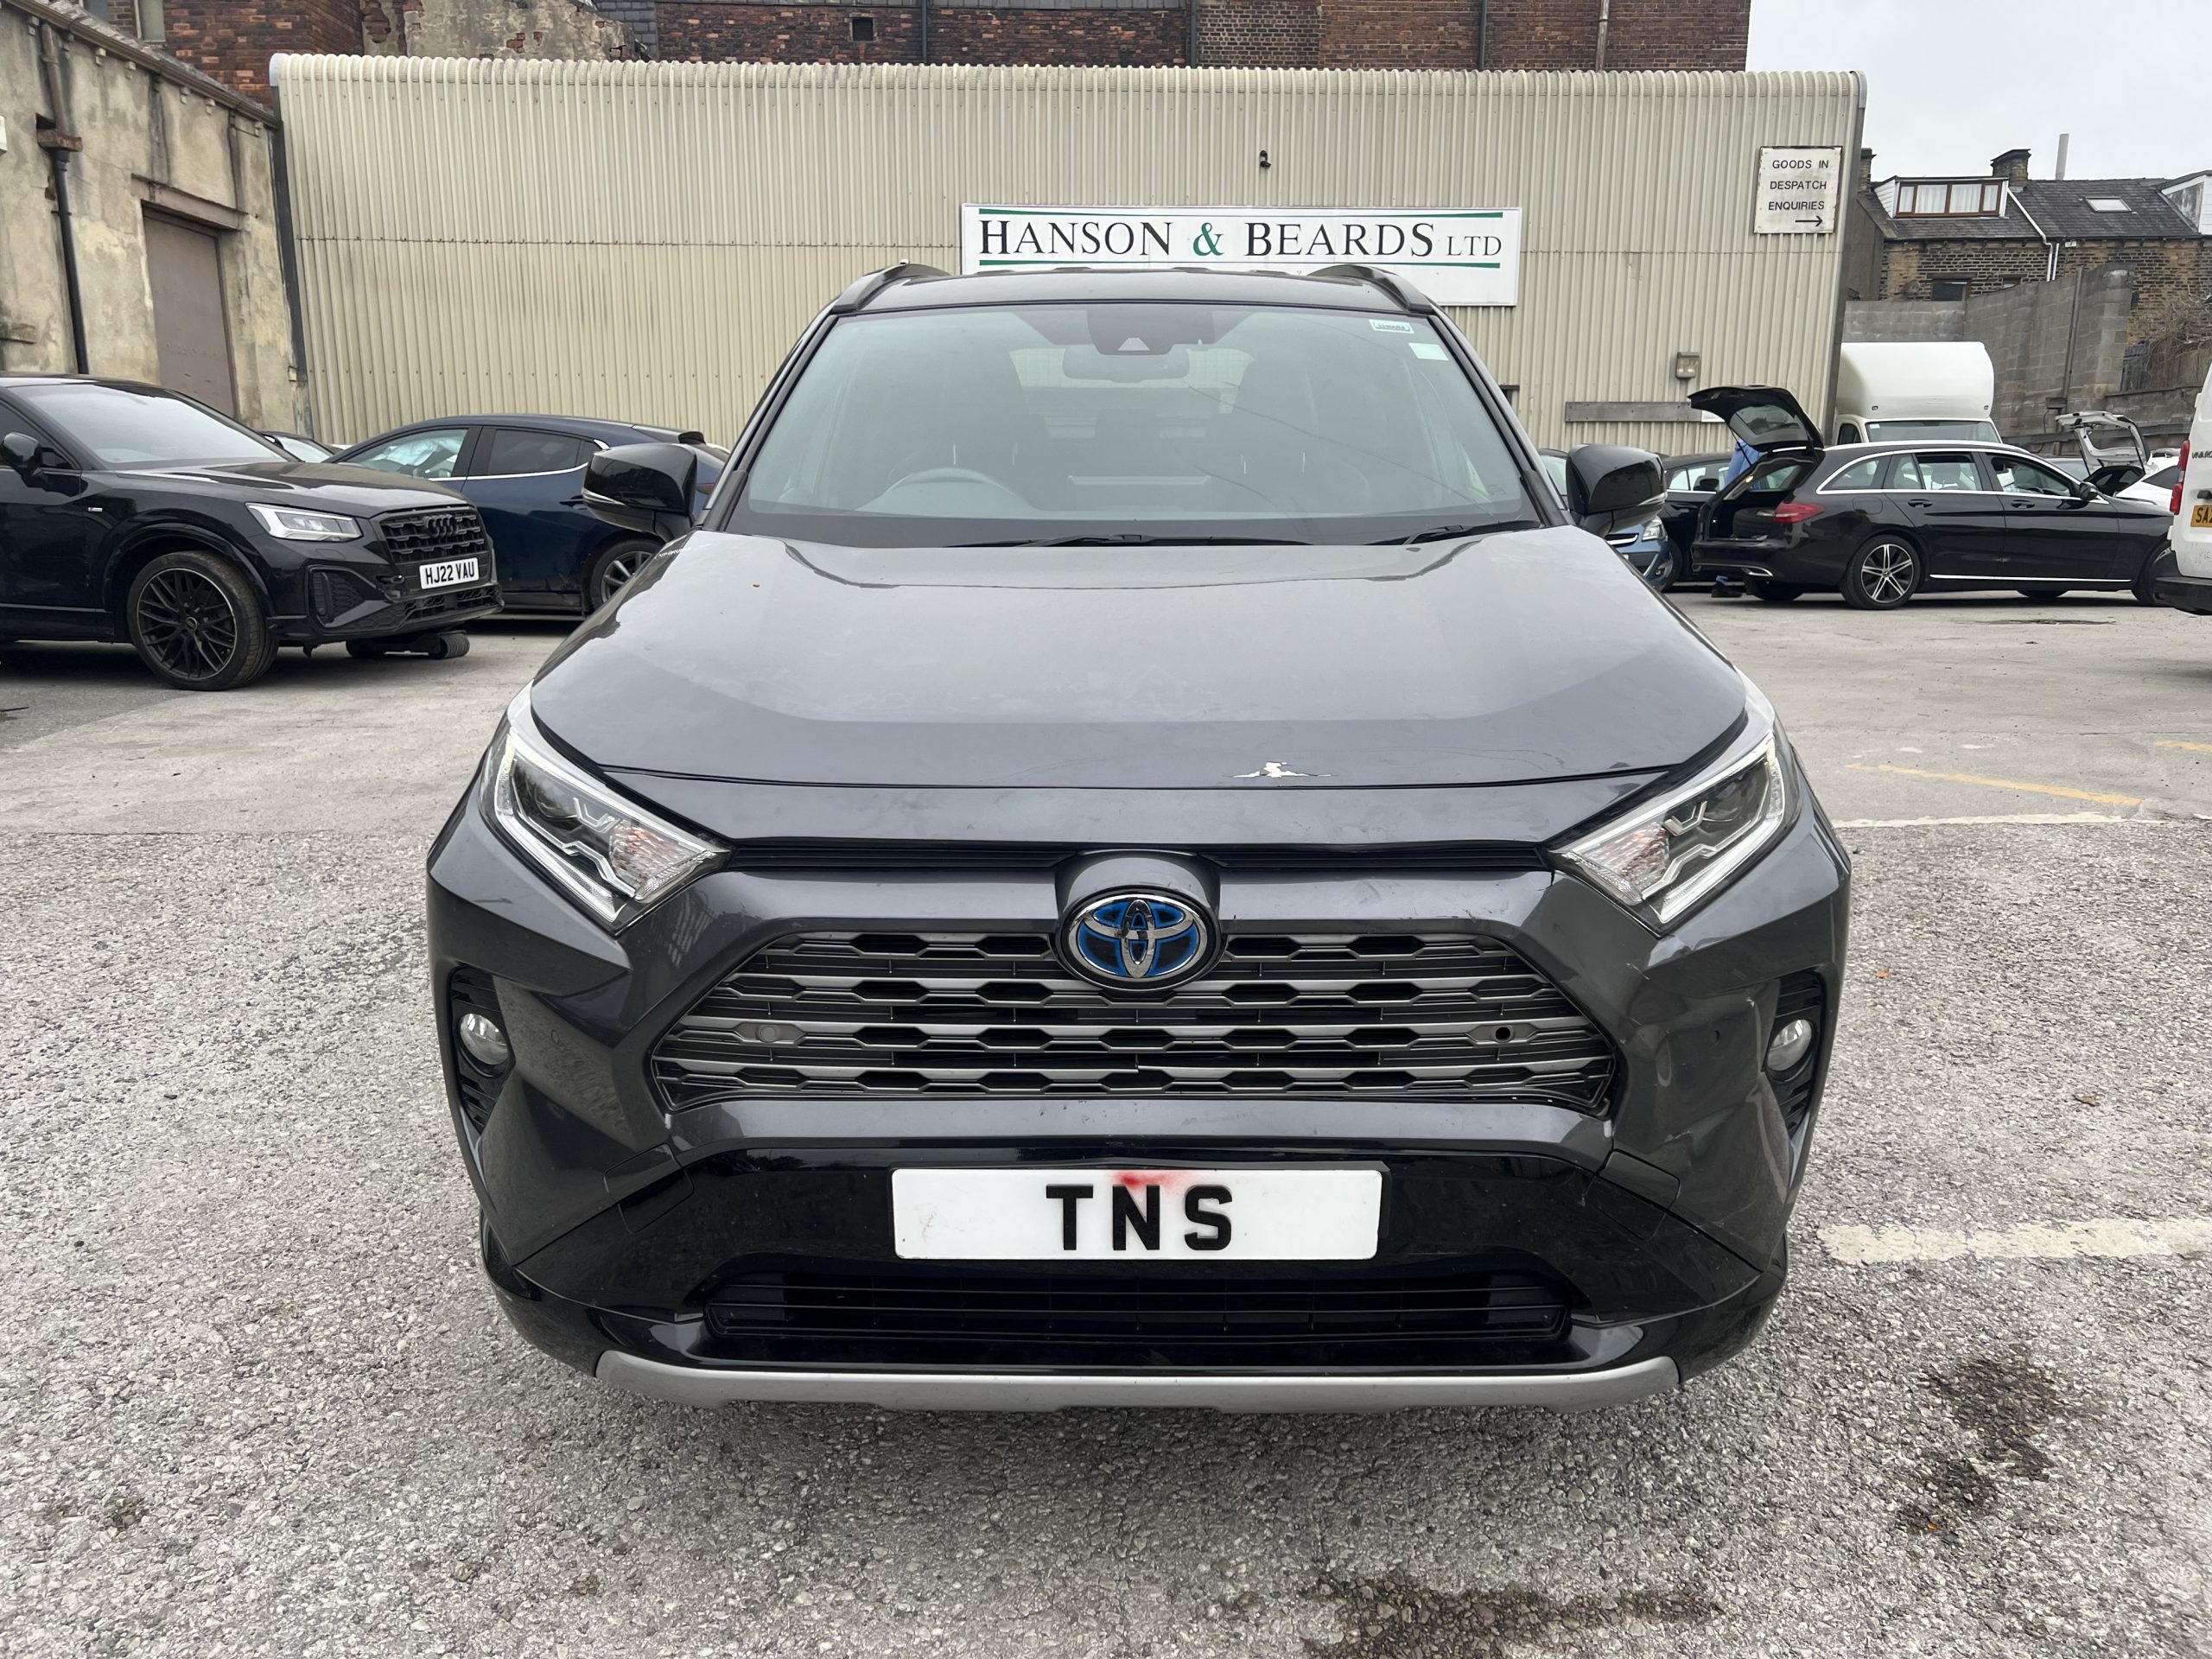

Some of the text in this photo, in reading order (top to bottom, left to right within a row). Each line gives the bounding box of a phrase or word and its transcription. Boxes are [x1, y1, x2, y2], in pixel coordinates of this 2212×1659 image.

[1772, 160, 1829, 168] GOODS IN
[1770, 181, 1827, 190] DESPATCH
[1768, 200, 1825, 211] ENQUIRIES
[979, 219, 1502, 257] HANSON & BEARDS LTD
[425, 561, 474, 585] HJ22 VAU
[1046, 1185, 1233, 1251] TNS
